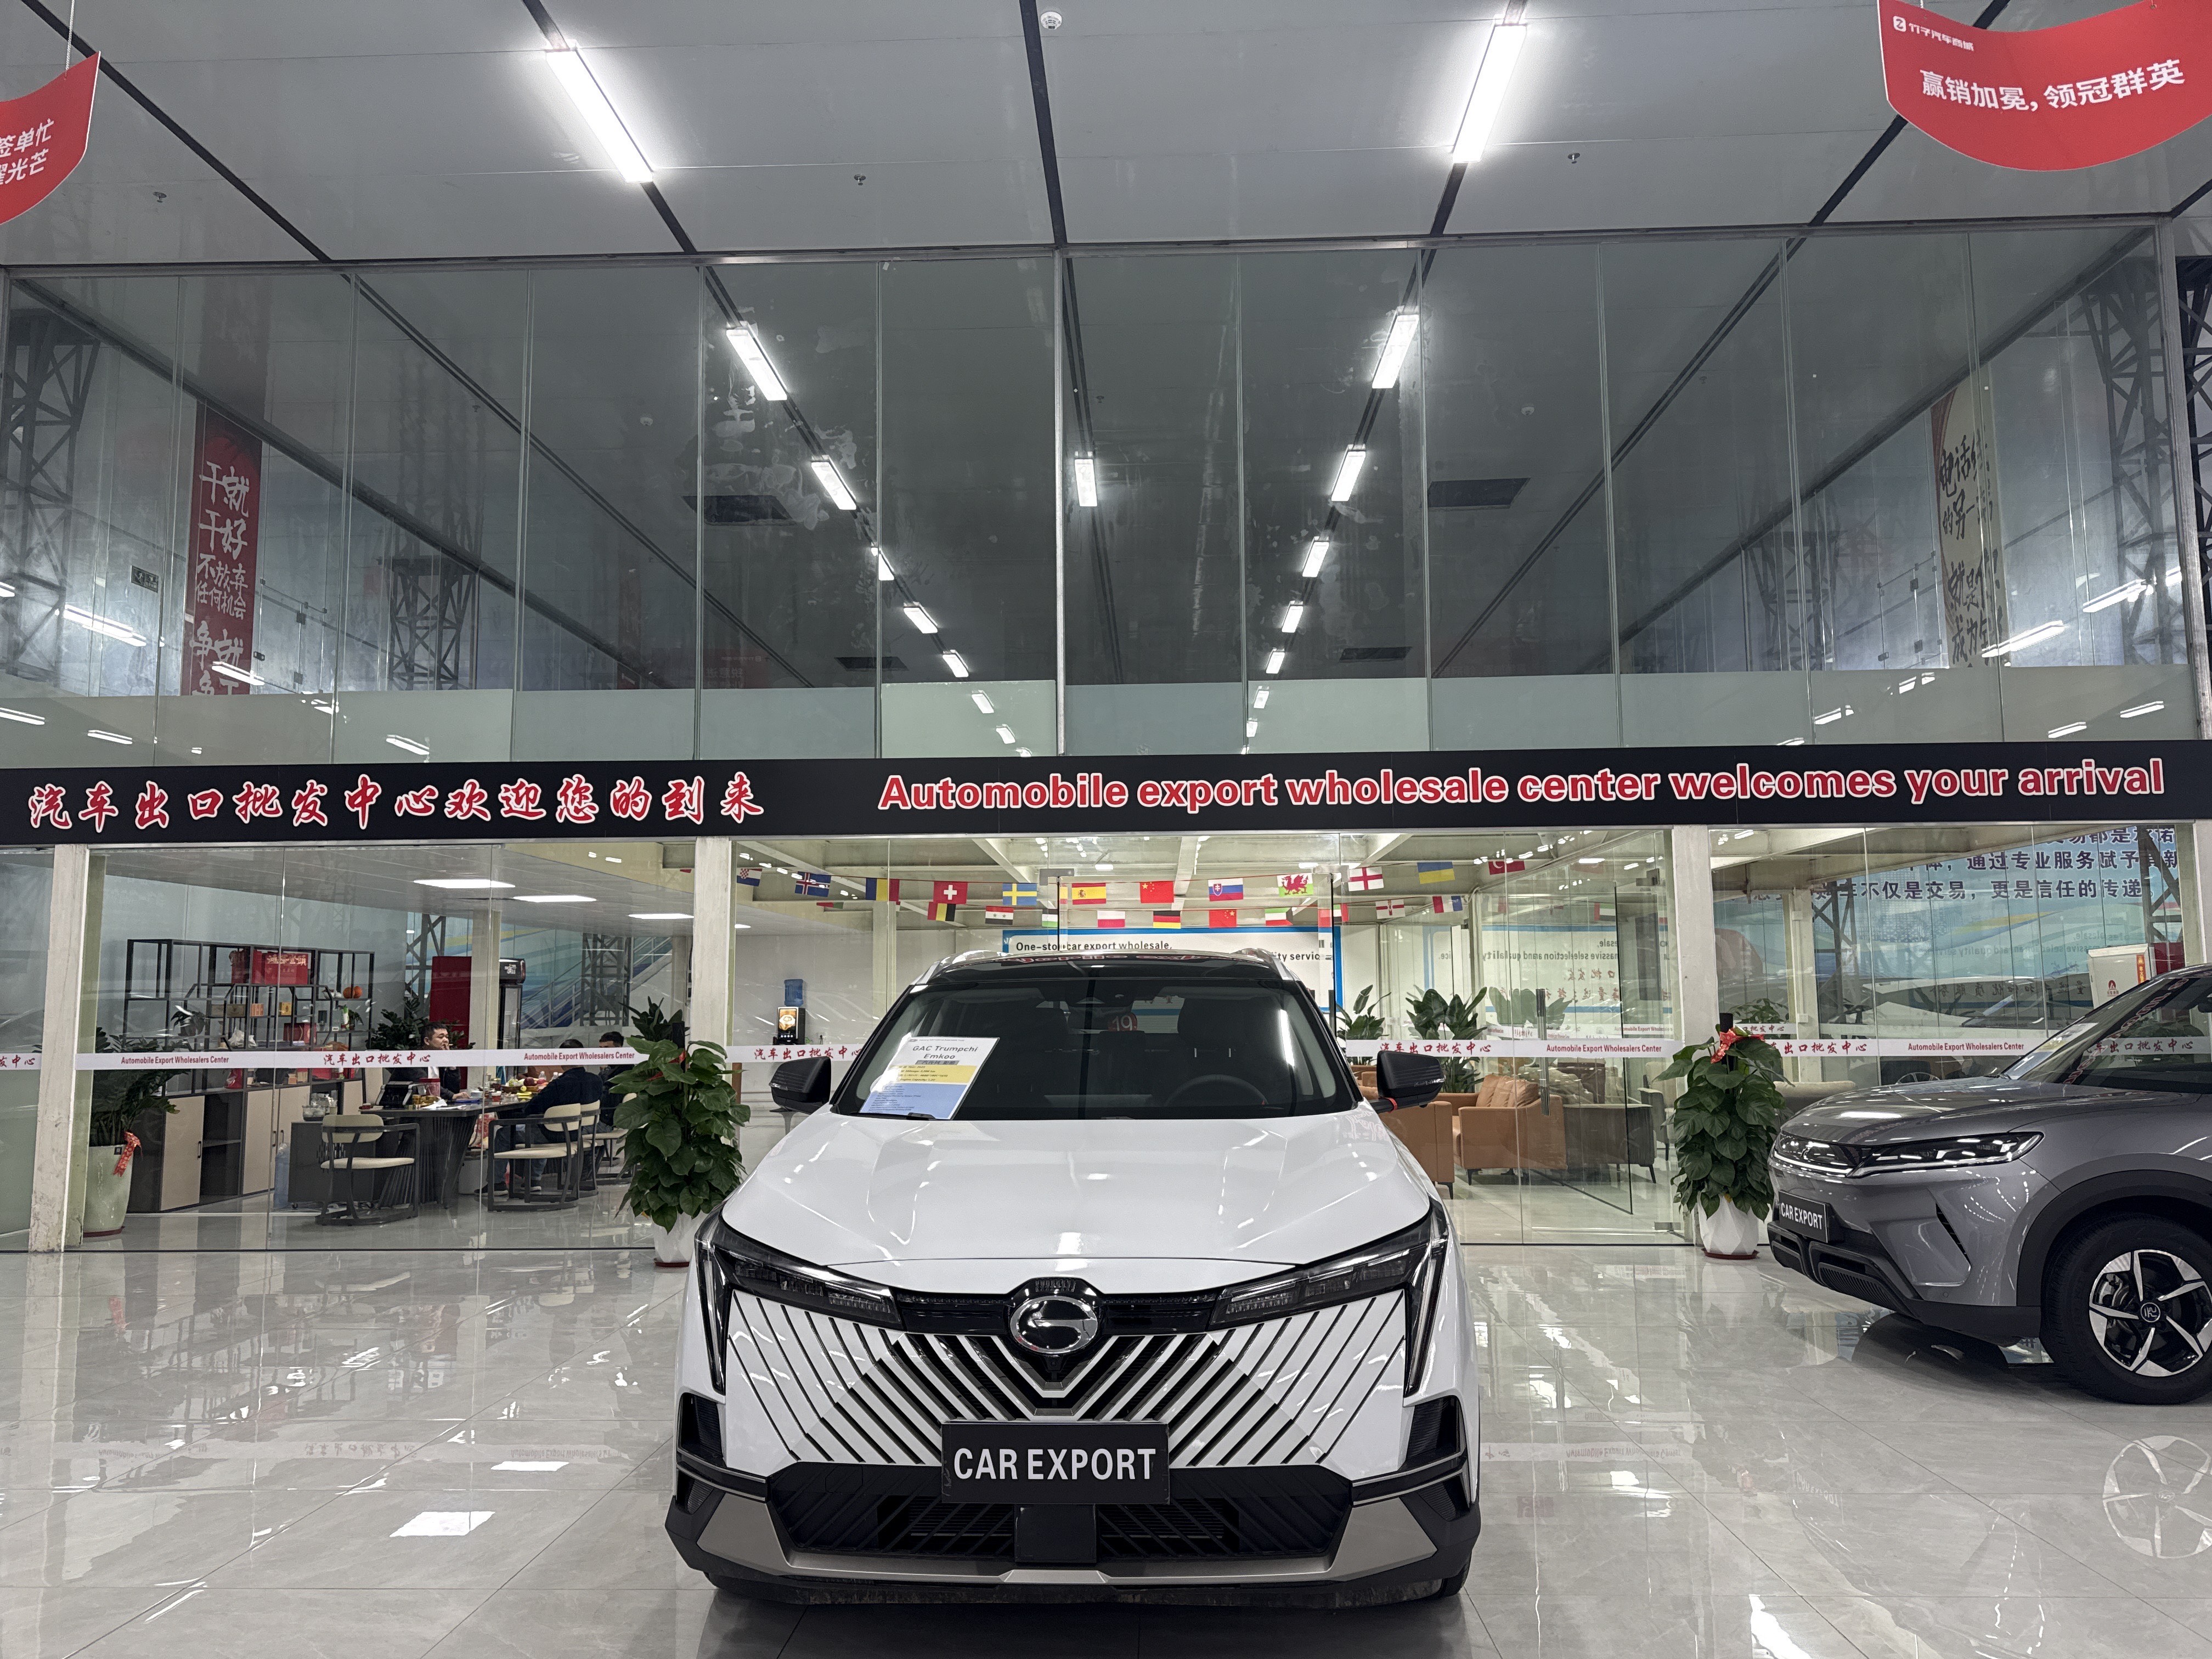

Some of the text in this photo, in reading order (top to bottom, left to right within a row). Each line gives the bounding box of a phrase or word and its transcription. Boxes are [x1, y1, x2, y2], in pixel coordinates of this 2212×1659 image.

[878, 758, 2164, 814] Automobile export wholesale center welcomes your arrival
[28, 771, 764, 833] 汽车出口批发中心欢迎您的到来
[1016, 942, 1060, 951] One-sto
[1084, 941, 1116, 950] export
[1290, 951, 1320, 960] servic
[1547, 1044, 1662, 1055] Automobile Export Wholesalers Center
[1908, 1042, 2024, 1052] Automobile Export Wholesalers Center
[155, 1057, 174, 1065] Export
[174, 1056, 209, 1064] Wholesalers
[323, 1052, 431, 1066] 汽车出口批发中心
[523, 1051, 635, 1062] Automobile Export Wholesalers Center
[1781, 1202, 1822, 1230] CAR EXPORT
[954, 1448, 1156, 1480] CAR EXPORT
